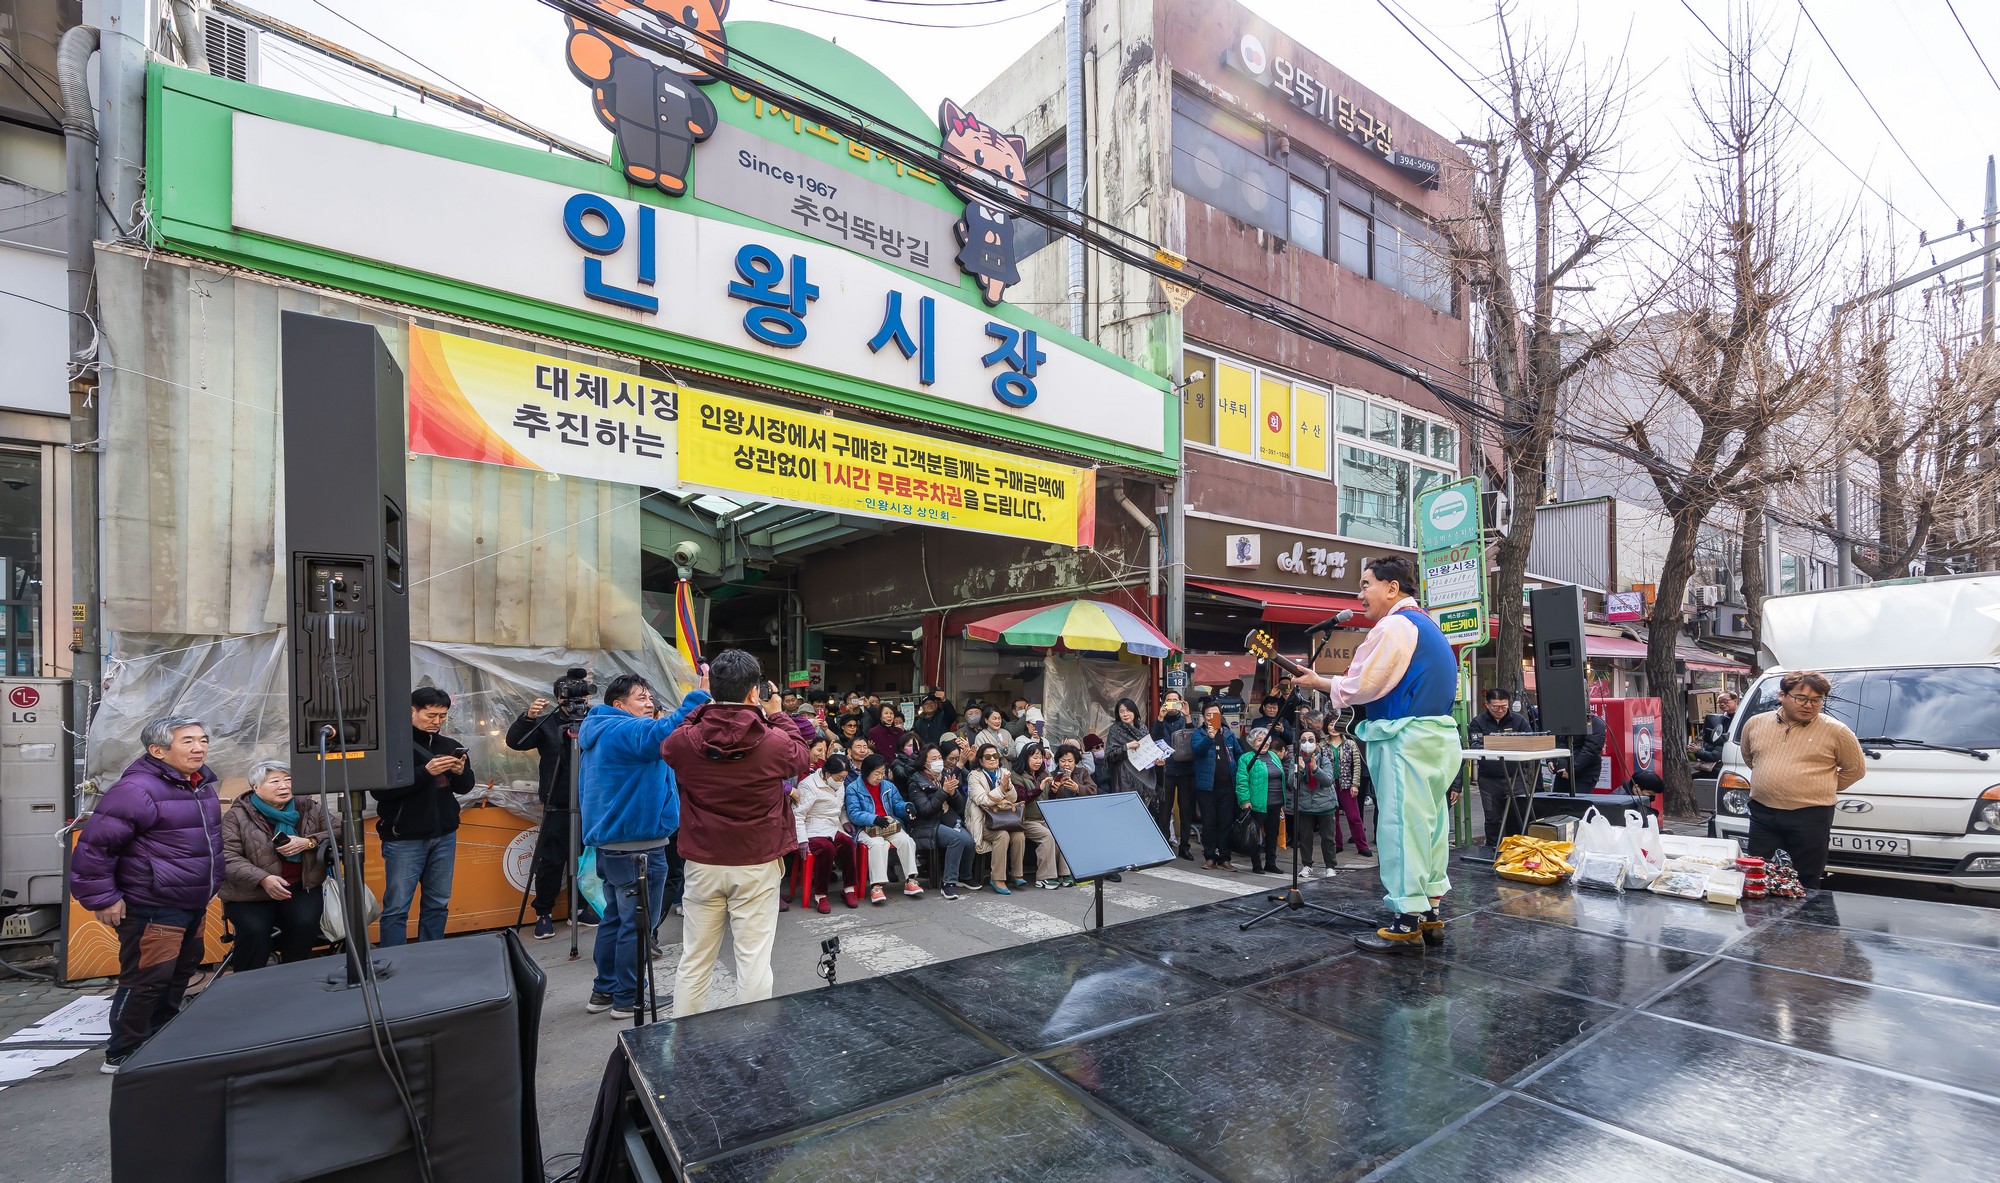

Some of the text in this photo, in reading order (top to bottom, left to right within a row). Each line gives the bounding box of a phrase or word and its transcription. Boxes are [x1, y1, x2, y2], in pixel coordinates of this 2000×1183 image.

[1273, 55, 1394, 155] 오뚜기 당구장
[1399, 154, 1437, 172] 394-5696
[790, 194, 930, 269] 추억뚝방길
[562, 192, 1047, 409] 인왕시장
[535, 364, 679, 422] 대체시장
[512, 403, 665, 460] 추진하는
[1218, 397, 1248, 418] 나루터
[1270, 415, 1280, 431] 회
[1300, 421, 1321, 439] 수산
[700, 404, 1065, 500] 인왕시장에서 구매한 고객분들께는 구매금액에
[733, 444, 1047, 522] 상관없이 1시간 무료주차권을 드립니다.
[1428, 559, 1476, 577] 인왕시장
[1450, 546, 1469, 563] 07
[1440, 617, 1478, 633] 애드케이
[1173, 678, 1183, 686] 18
[12, 711, 37, 723] LG
[1852, 837, 1898, 853] 0199
